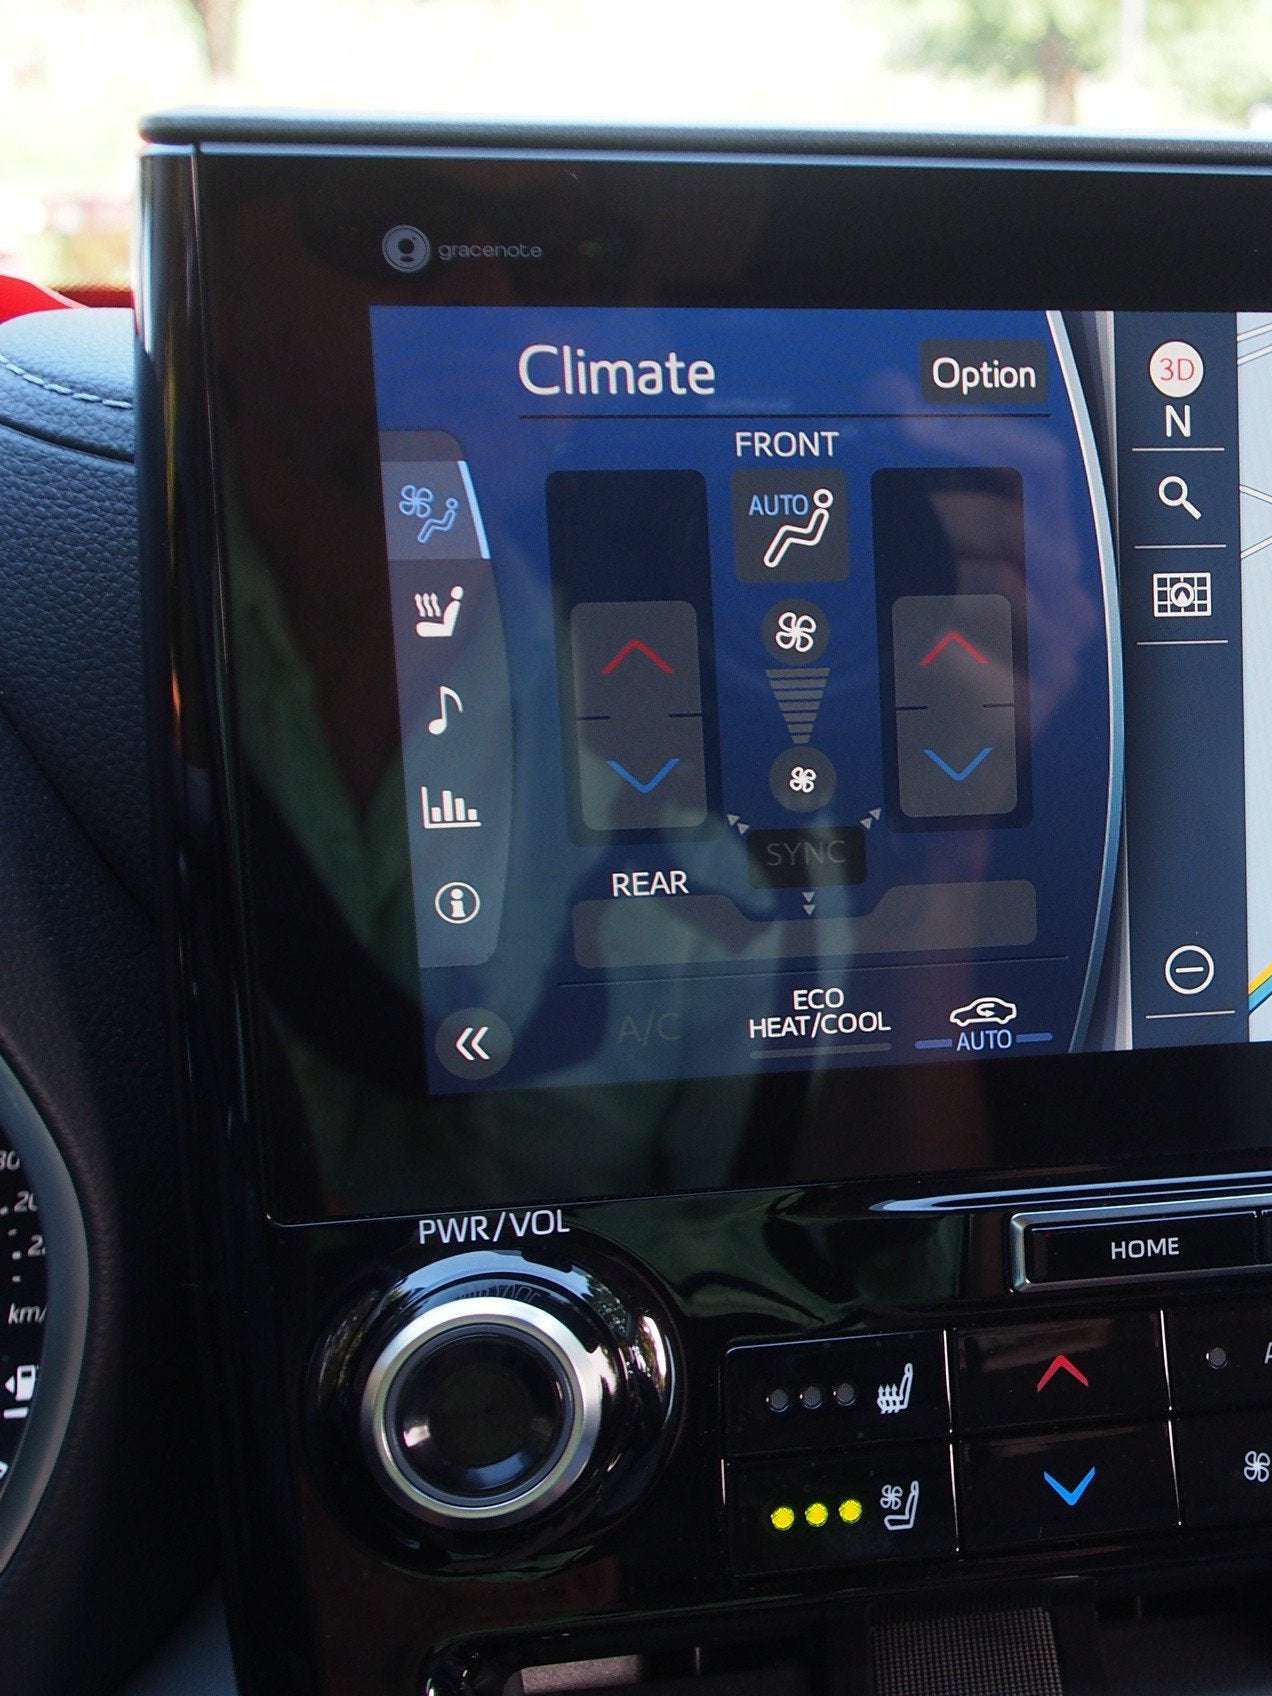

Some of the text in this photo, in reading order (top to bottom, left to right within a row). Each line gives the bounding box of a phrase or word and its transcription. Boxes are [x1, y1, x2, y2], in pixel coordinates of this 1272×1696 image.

[437, 243, 544, 261] gracenote
[517, 345, 716, 395] Climate
[931, 355, 1037, 394] Option
[1158, 357, 1196, 382] 3D
[1165, 405, 1191, 438] N
[735, 431, 839, 457] FRONT
[748, 494, 808, 516] AUTO
[766, 840, 847, 867] SYNC
[611, 870, 690, 898] REAR
[792, 988, 845, 1010] ECO
[617, 1011, 681, 1044] A/C
[748, 1010, 892, 1040] HEAT/COOL
[956, 1029, 1013, 1051] AUTO
[418, 1209, 571, 1245] PWR/VOL
[1110, 1237, 1180, 1260] HOME
